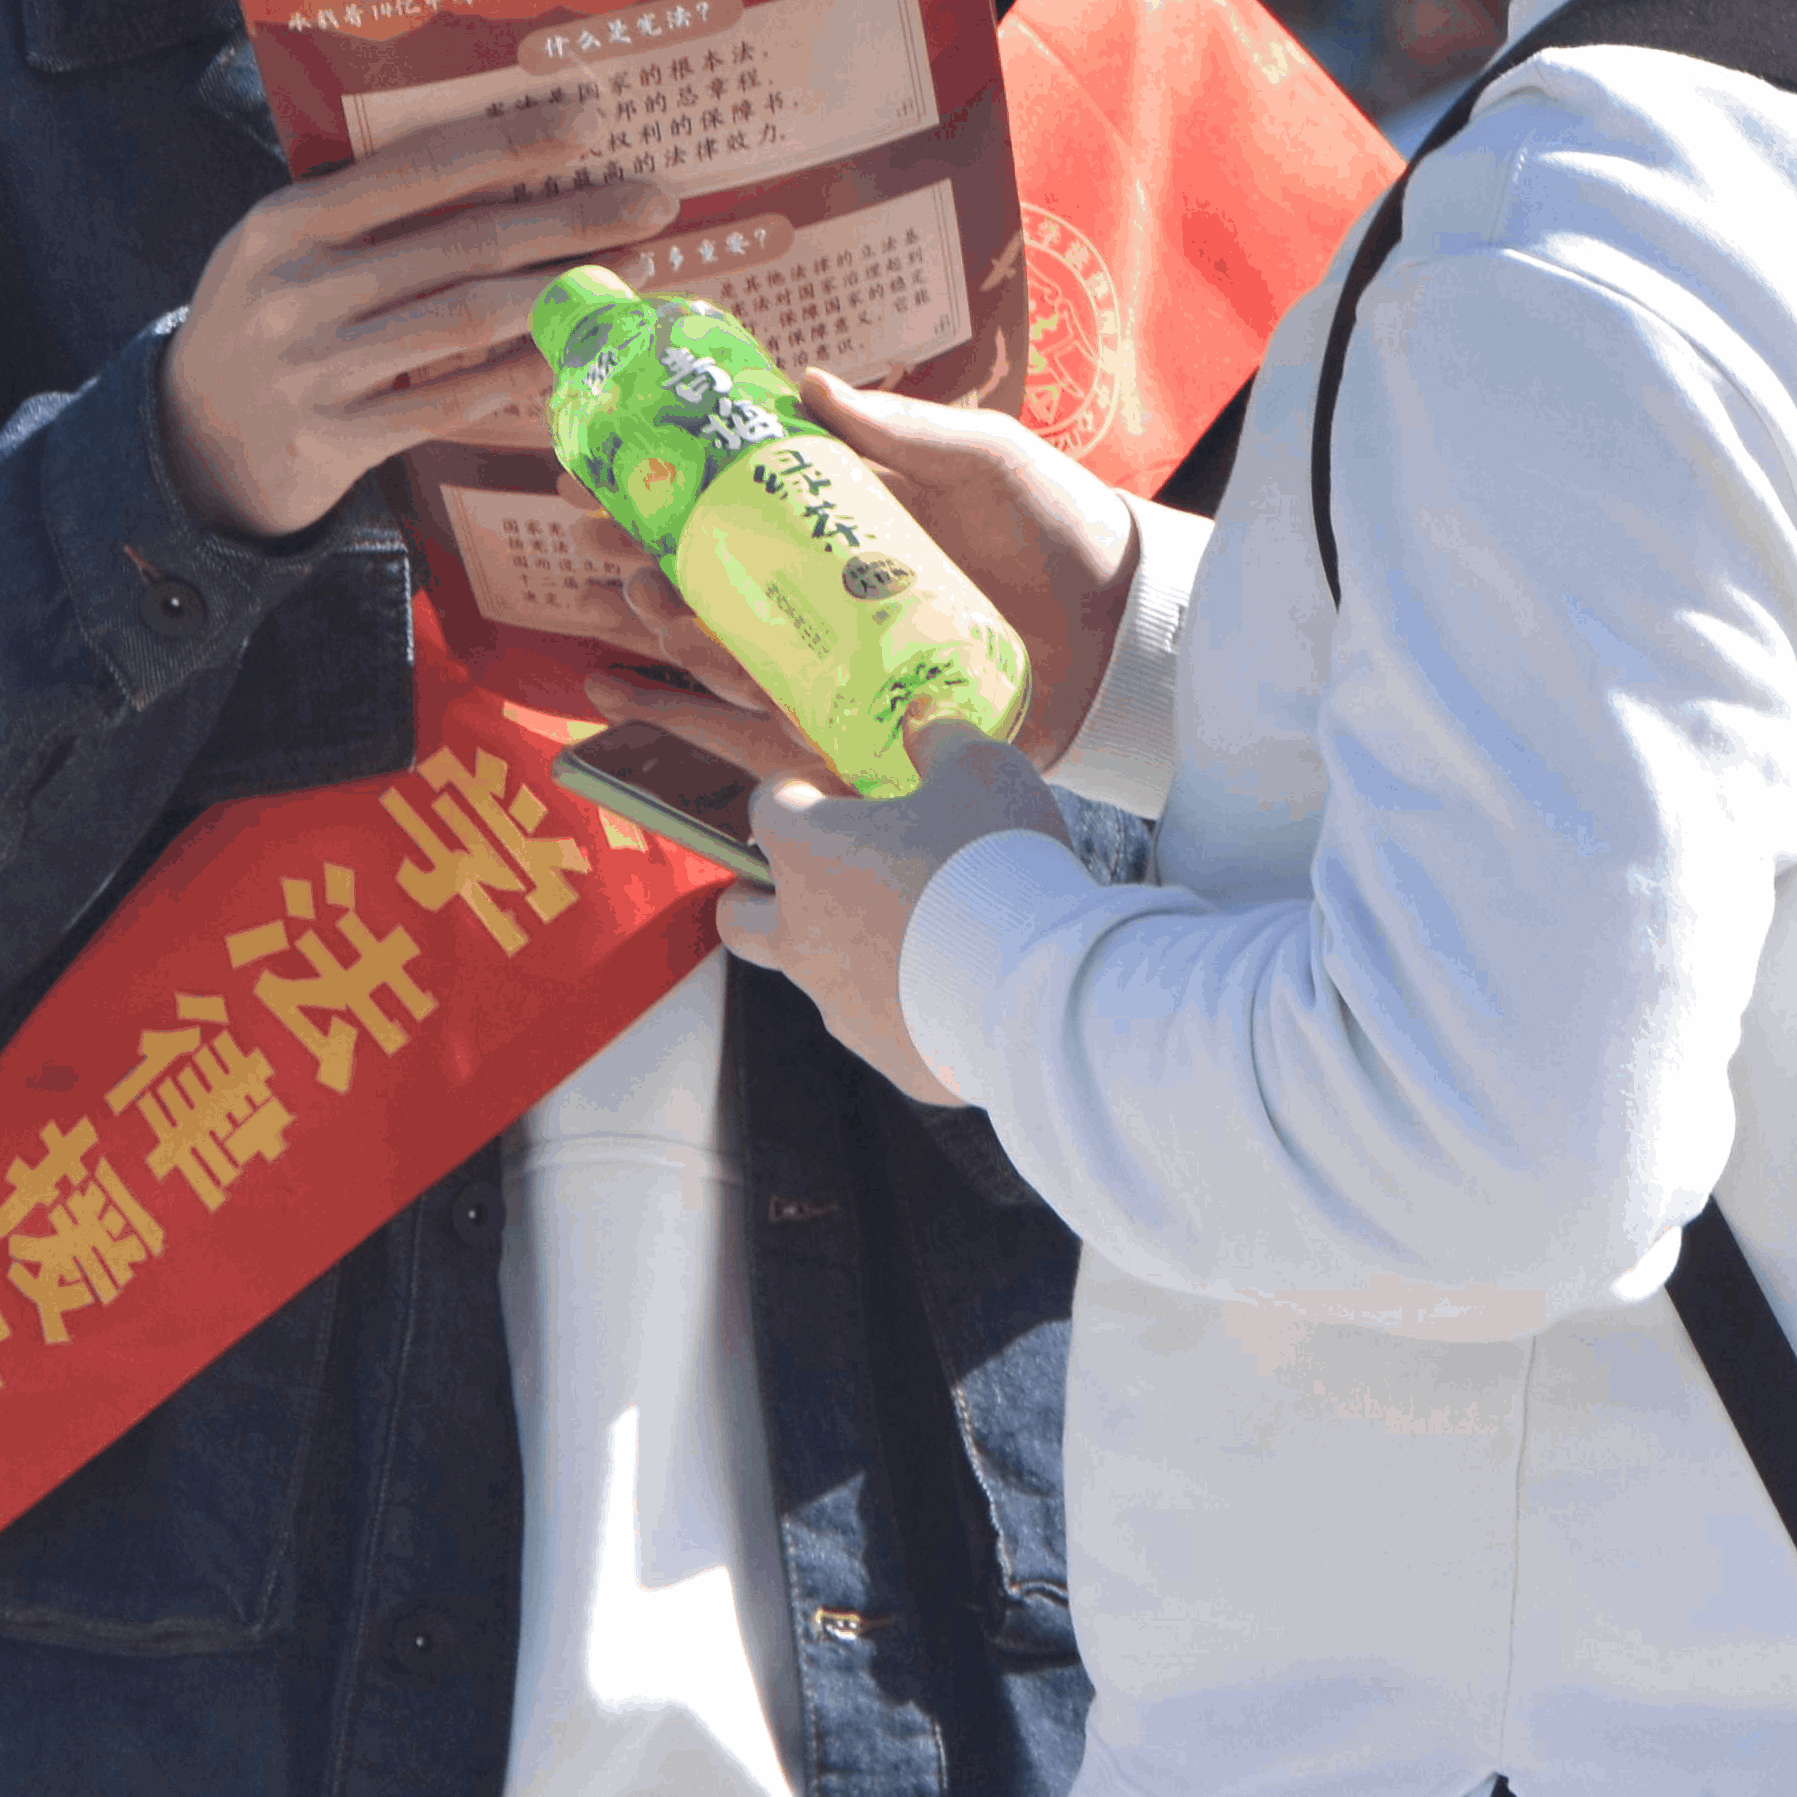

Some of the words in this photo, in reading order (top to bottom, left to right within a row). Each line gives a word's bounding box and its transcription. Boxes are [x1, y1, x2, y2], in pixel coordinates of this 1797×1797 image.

[544, 1, 711, 59] 什么是宪法？
[596, 67, 775, 121] 邦的总章程，
